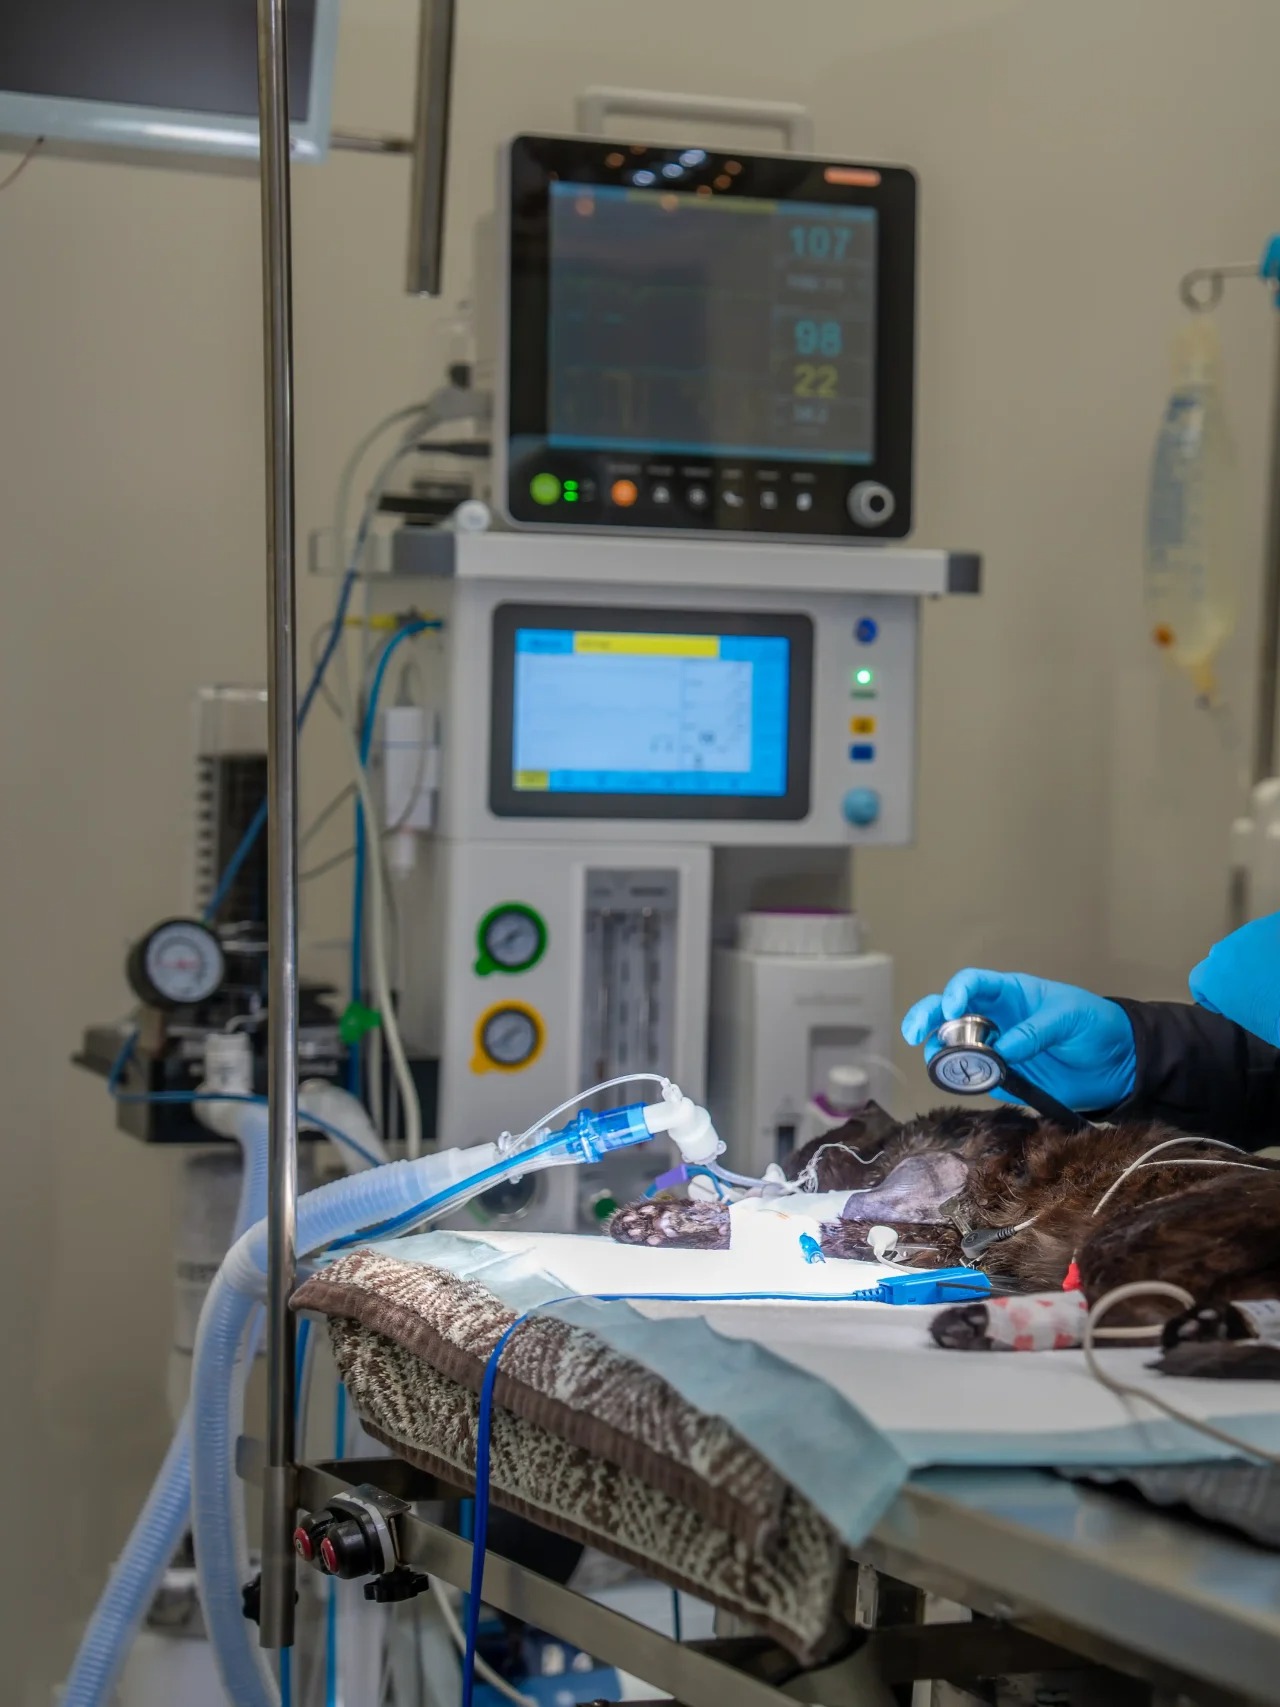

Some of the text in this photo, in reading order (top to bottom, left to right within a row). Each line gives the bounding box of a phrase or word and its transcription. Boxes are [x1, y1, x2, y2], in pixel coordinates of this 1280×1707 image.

[789, 225, 853, 261] 107
[795, 319, 842, 358] 98
[793, 363, 839, 398] 22
